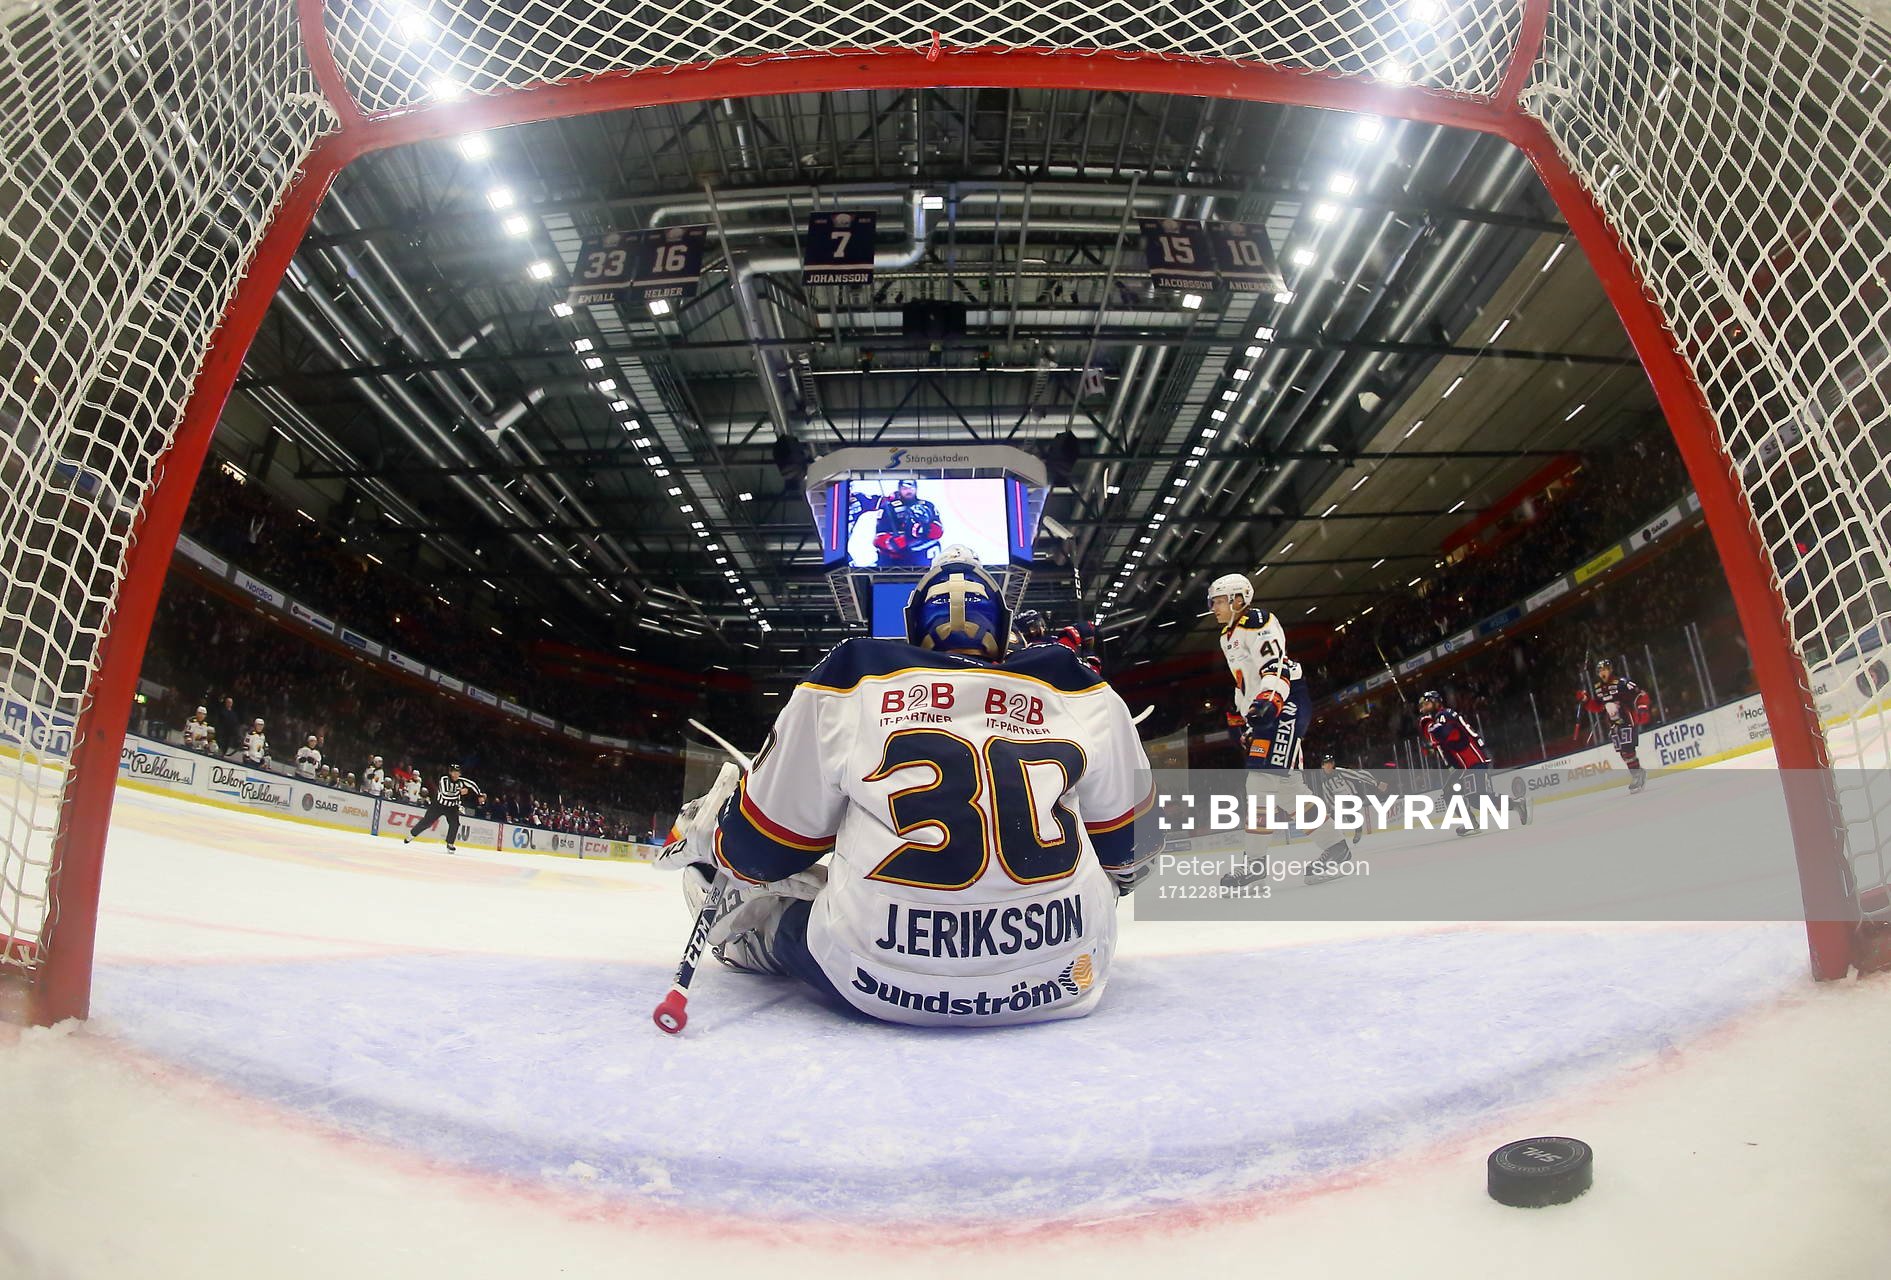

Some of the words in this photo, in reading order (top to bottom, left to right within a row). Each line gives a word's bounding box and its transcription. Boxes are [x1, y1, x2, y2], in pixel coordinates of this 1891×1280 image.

[831, 231, 852, 258] 7
[1159, 236, 1195, 264] 15
[1227, 239, 1264, 266] 10
[584, 250, 627, 279] 33
[652, 245, 689, 273] 16
[807, 273, 869, 284] JOHANSSON
[1159, 278, 1214, 290] JACOBSSON
[644, 287, 683, 299] HELBER
[905, 452, 970, 464] Stångåstaden
[1651, 519, 1669, 535] SAAB
[245, 580, 273, 602] Nordea
[881, 682, 955, 714] B2B
[984, 687, 1044, 726] B2B
[879, 712, 953, 727] IT-PARTNER
[986, 718, 1050, 735] IT-PARTNER
[1654, 721, 1705, 750] ActiPro
[1270, 717, 1295, 767] REFIX
[1660, 742, 1703, 767] Event
[131, 754, 181, 783] Reklam
[212, 766, 245, 789] Dekor
[1528, 773, 1560, 792] SAAB
[1567, 760, 1613, 782] ARENA
[241, 783, 281, 805] Reklam
[315, 800, 339, 812] SAAB
[342, 805, 369, 818] ARENA
[862, 728, 1087, 891] 30
[585, 841, 608, 853] CCM
[876, 894, 1083, 958] J.ERIKSSON
[685, 915, 712, 969] CCM
[852, 966, 1062, 1015] Sundström
